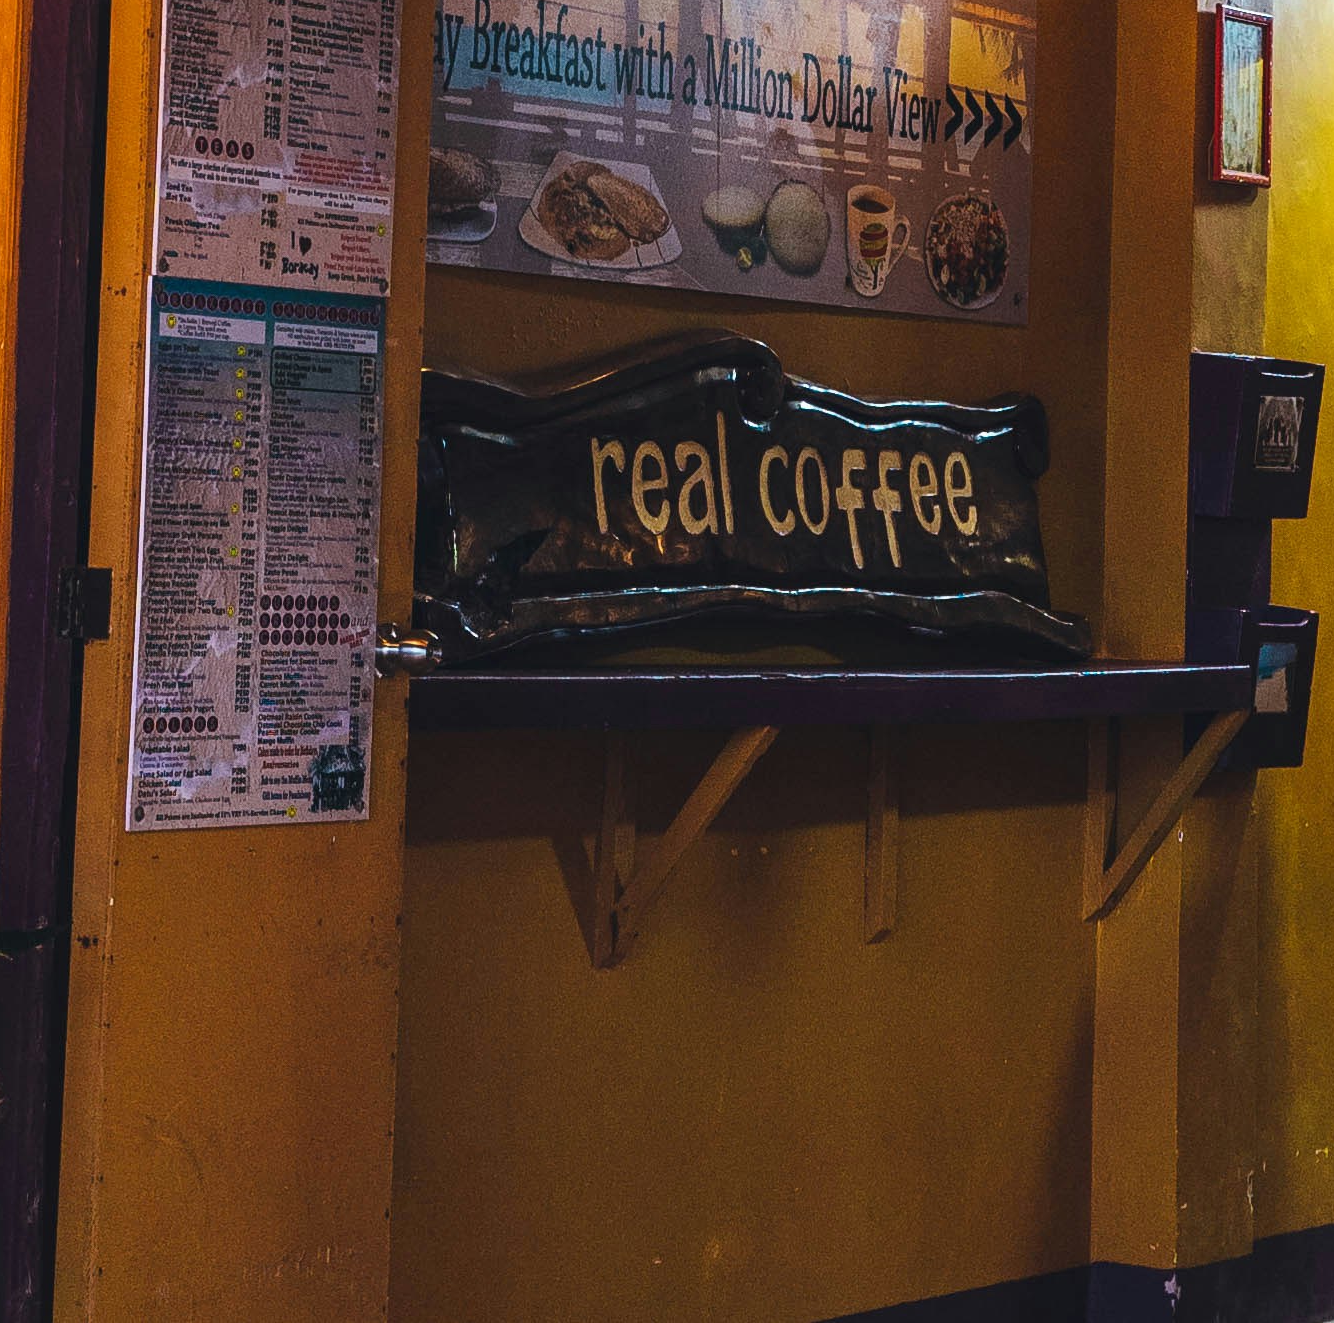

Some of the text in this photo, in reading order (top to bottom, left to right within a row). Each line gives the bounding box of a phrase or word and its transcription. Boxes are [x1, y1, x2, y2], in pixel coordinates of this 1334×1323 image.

[613, 20, 674, 102] with
[683, 63, 697, 105] a
[705, 33, 793, 119] Million
[802, 52, 875, 133] Dollar
[884, 67, 941, 143] View
[195, 136, 254, 160] TEAS
[282, 257, 319, 280] Boracay
[590, 410, 977, 569] real coffee
[138, 780, 163, 788] Chicken
